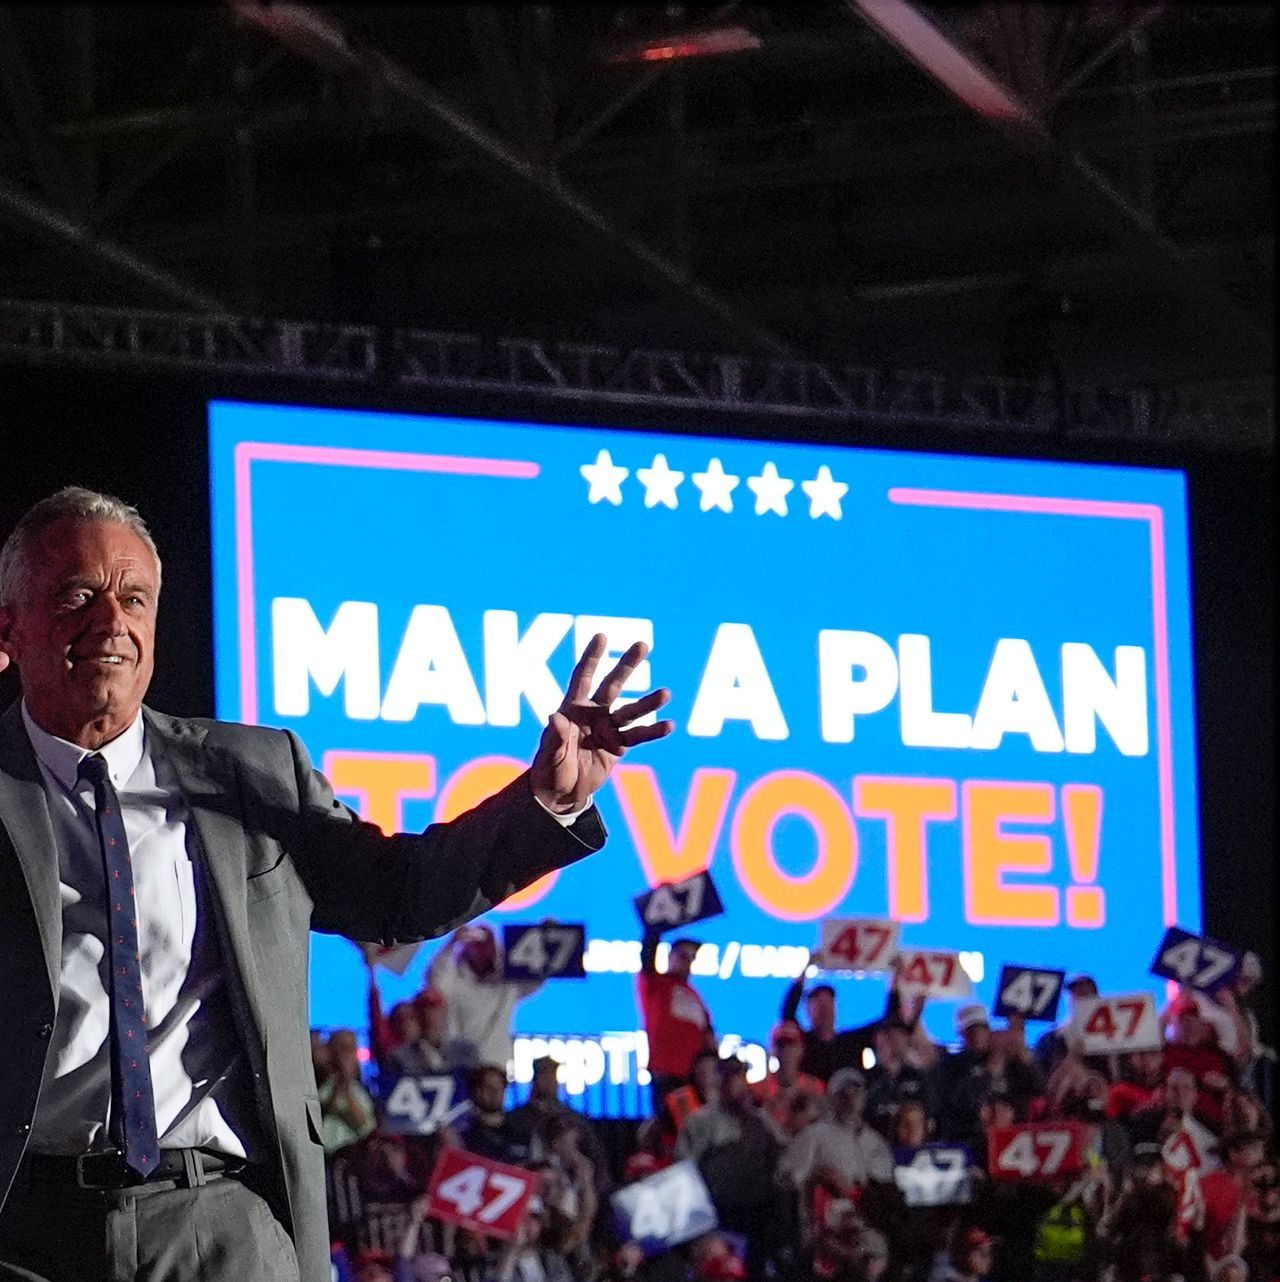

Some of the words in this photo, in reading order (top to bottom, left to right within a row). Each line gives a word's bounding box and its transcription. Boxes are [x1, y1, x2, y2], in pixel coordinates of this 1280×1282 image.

[271, 597, 654, 727] MAKE
[687, 622, 788, 740] A
[818, 628, 1149, 756] PLAN
[612, 764, 1105, 928] VOTE!
[645, 876, 706, 926] 47
[508, 928, 579, 972] 47
[829, 926, 891, 965] 47
[1162, 940, 1236, 985] 47
[902, 954, 957, 987] 47
[1001, 972, 1060, 1014] 47
[1086, 1002, 1146, 1040] 47
[387, 1076, 456, 1132] 47
[999, 1132, 1072, 1175] 47
[440, 1165, 526, 1224] 47
